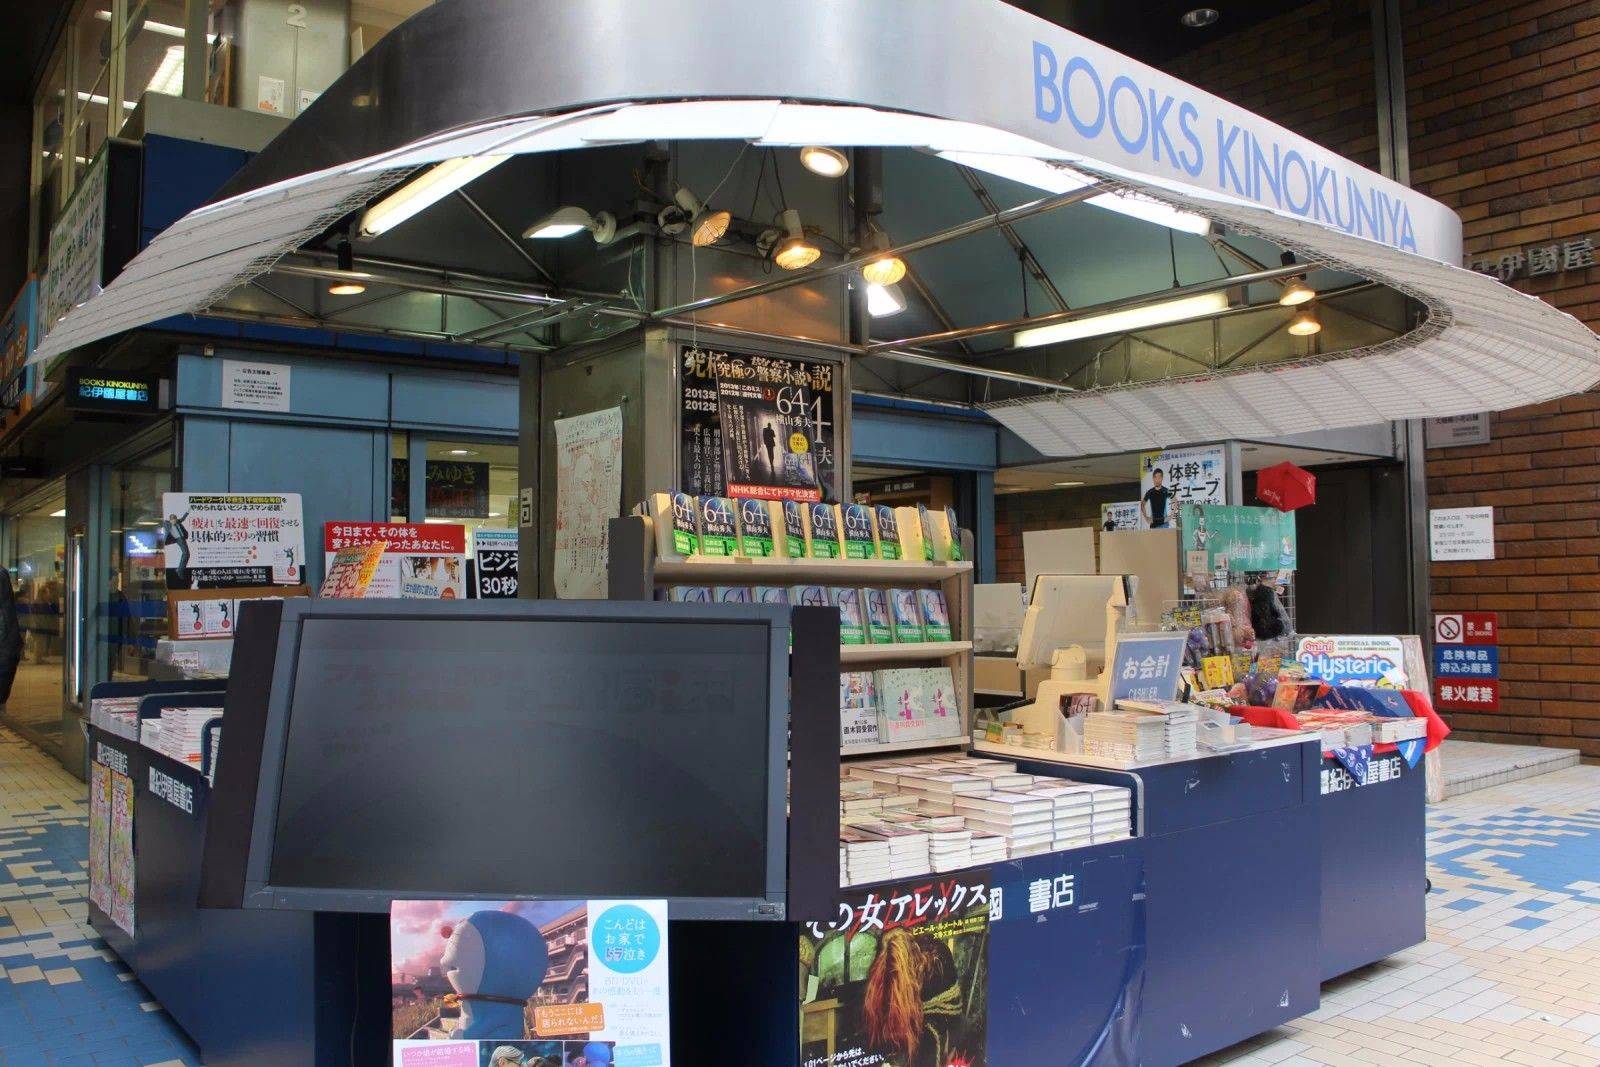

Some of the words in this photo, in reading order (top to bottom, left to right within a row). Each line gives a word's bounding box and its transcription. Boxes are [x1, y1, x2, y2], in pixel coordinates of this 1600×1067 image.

[286, 4, 307, 29] 2
[1032, 40, 1202, 178] BOOKS
[1217, 116, 1418, 254] KINOKUNIYA
[79, 378, 105, 387] BOOKS
[106, 380, 148, 390] KINOKUNIYA
[717, 361, 811, 387] 究極の警察小説
[79, 386, 149, 402] 紀伊國屋書店
[685, 388, 717, 400] 2013年
[777, 386, 809, 415] 64
[685, 400, 717, 412] 2012年
[1169, 461, 1200, 482] 体幹
[1168, 477, 1220, 499] チューブ
[674, 494, 693, 522] 64
[704, 498, 731, 525] 64
[743, 500, 767, 524] 64
[786, 501, 801, 527] 64
[813, 502, 834, 529] 64
[846, 505, 869, 529] 64
[1115, 508, 1130, 519] 体幹
[880, 506, 897, 531] 64
[190, 530, 280, 543] 具体的な39の習慣
[332, 525, 418, 538] 今日まで、その体を
[481, 577, 518, 595] 30秒
[869, 590, 887, 613] 64
[1303, 641, 1334, 652] mini
[1443, 650, 1488, 661] 危険物品
[1123, 654, 1170, 680] お会計
[1302, 653, 1391, 682] Hysteric
[1440, 662, 1492, 673] 持込み厳禁
[1441, 685, 1493, 702] 裸火厳禁
[1330, 756, 1401, 793] 紀伊屋書店
[604, 918, 646, 930] こんどは
[912, 919, 964, 936] ピエール・ルメートル
[605, 933, 646, 945] お家で
[605, 946, 647, 961] ドラ泣き
[804, 1047, 865, 1067] 101ページから先は、
